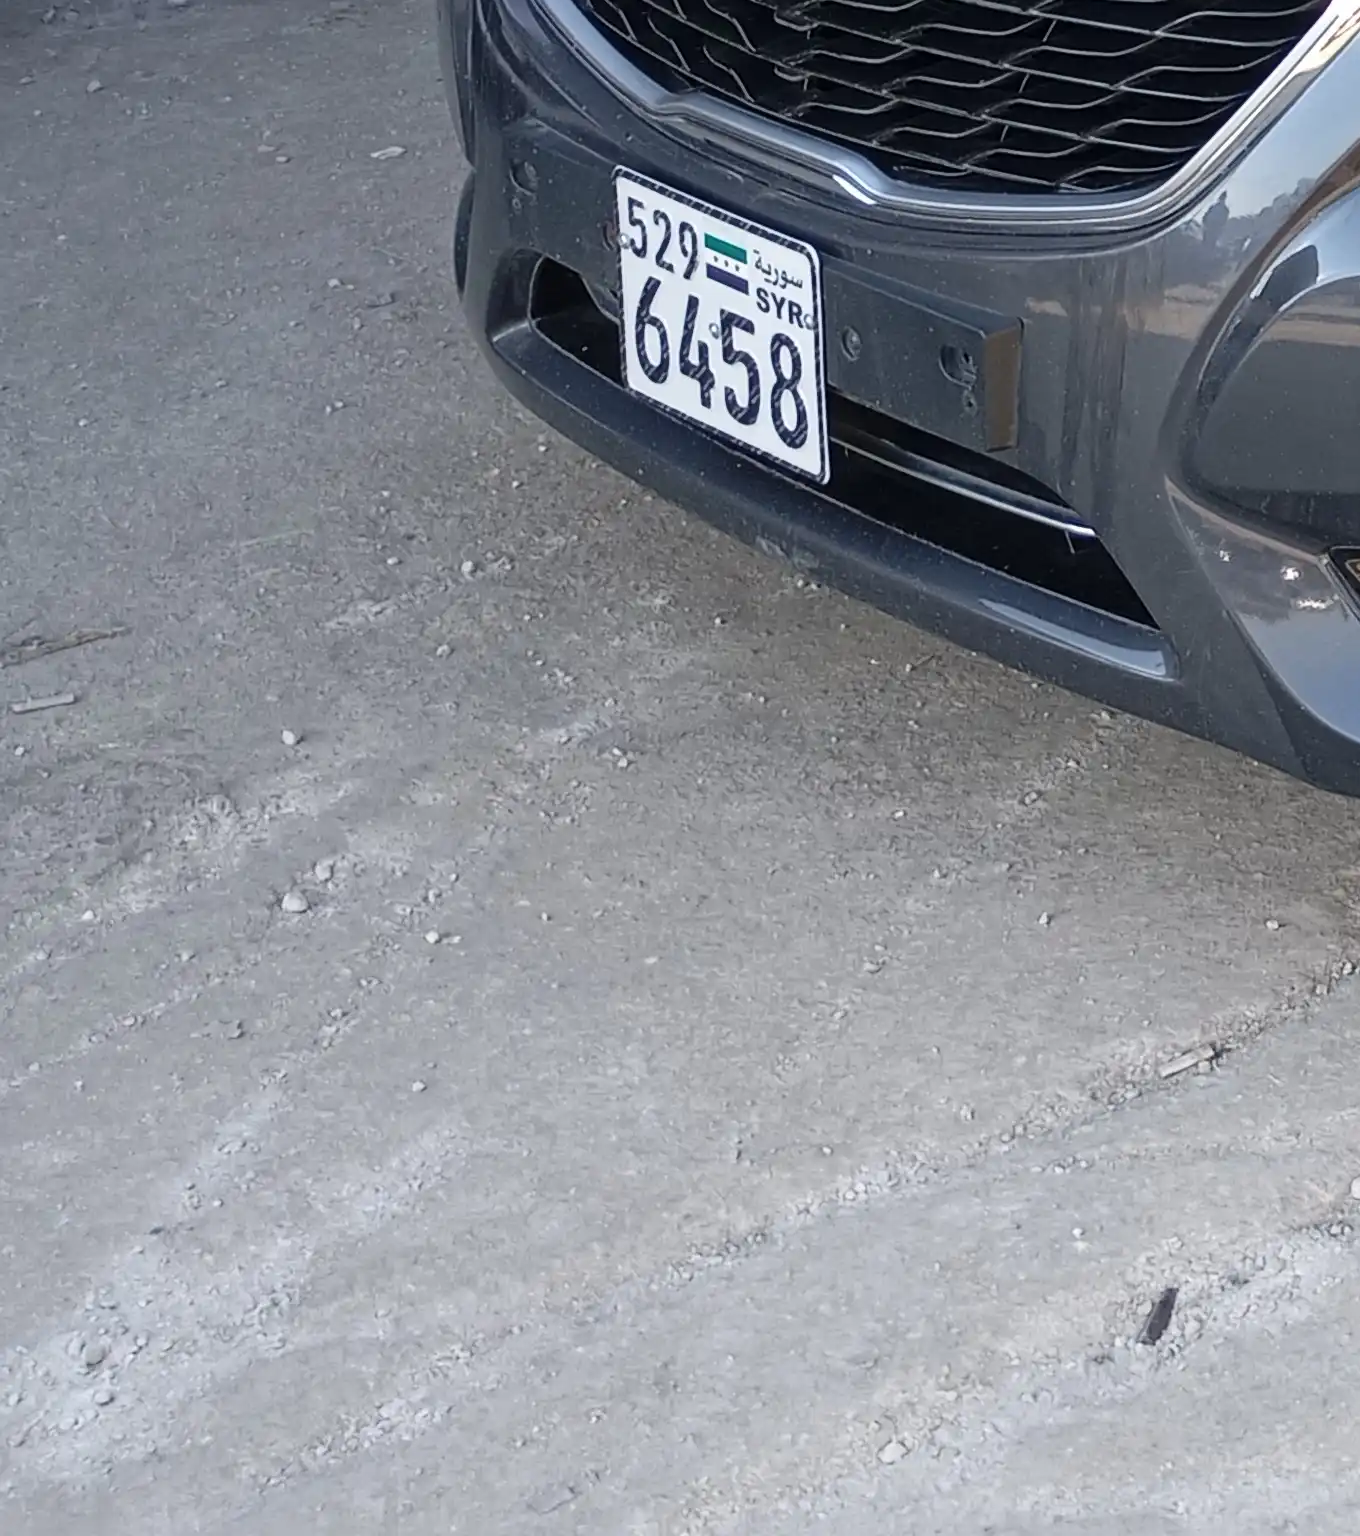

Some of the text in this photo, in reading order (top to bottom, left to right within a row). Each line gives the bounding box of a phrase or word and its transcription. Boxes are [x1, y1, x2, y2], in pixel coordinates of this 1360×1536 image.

[628, 196, 700, 280] 529
[753, 249, 803, 289] سورية
[756, 287, 804, 329] SYR
[635, 276, 808, 449] 6458
